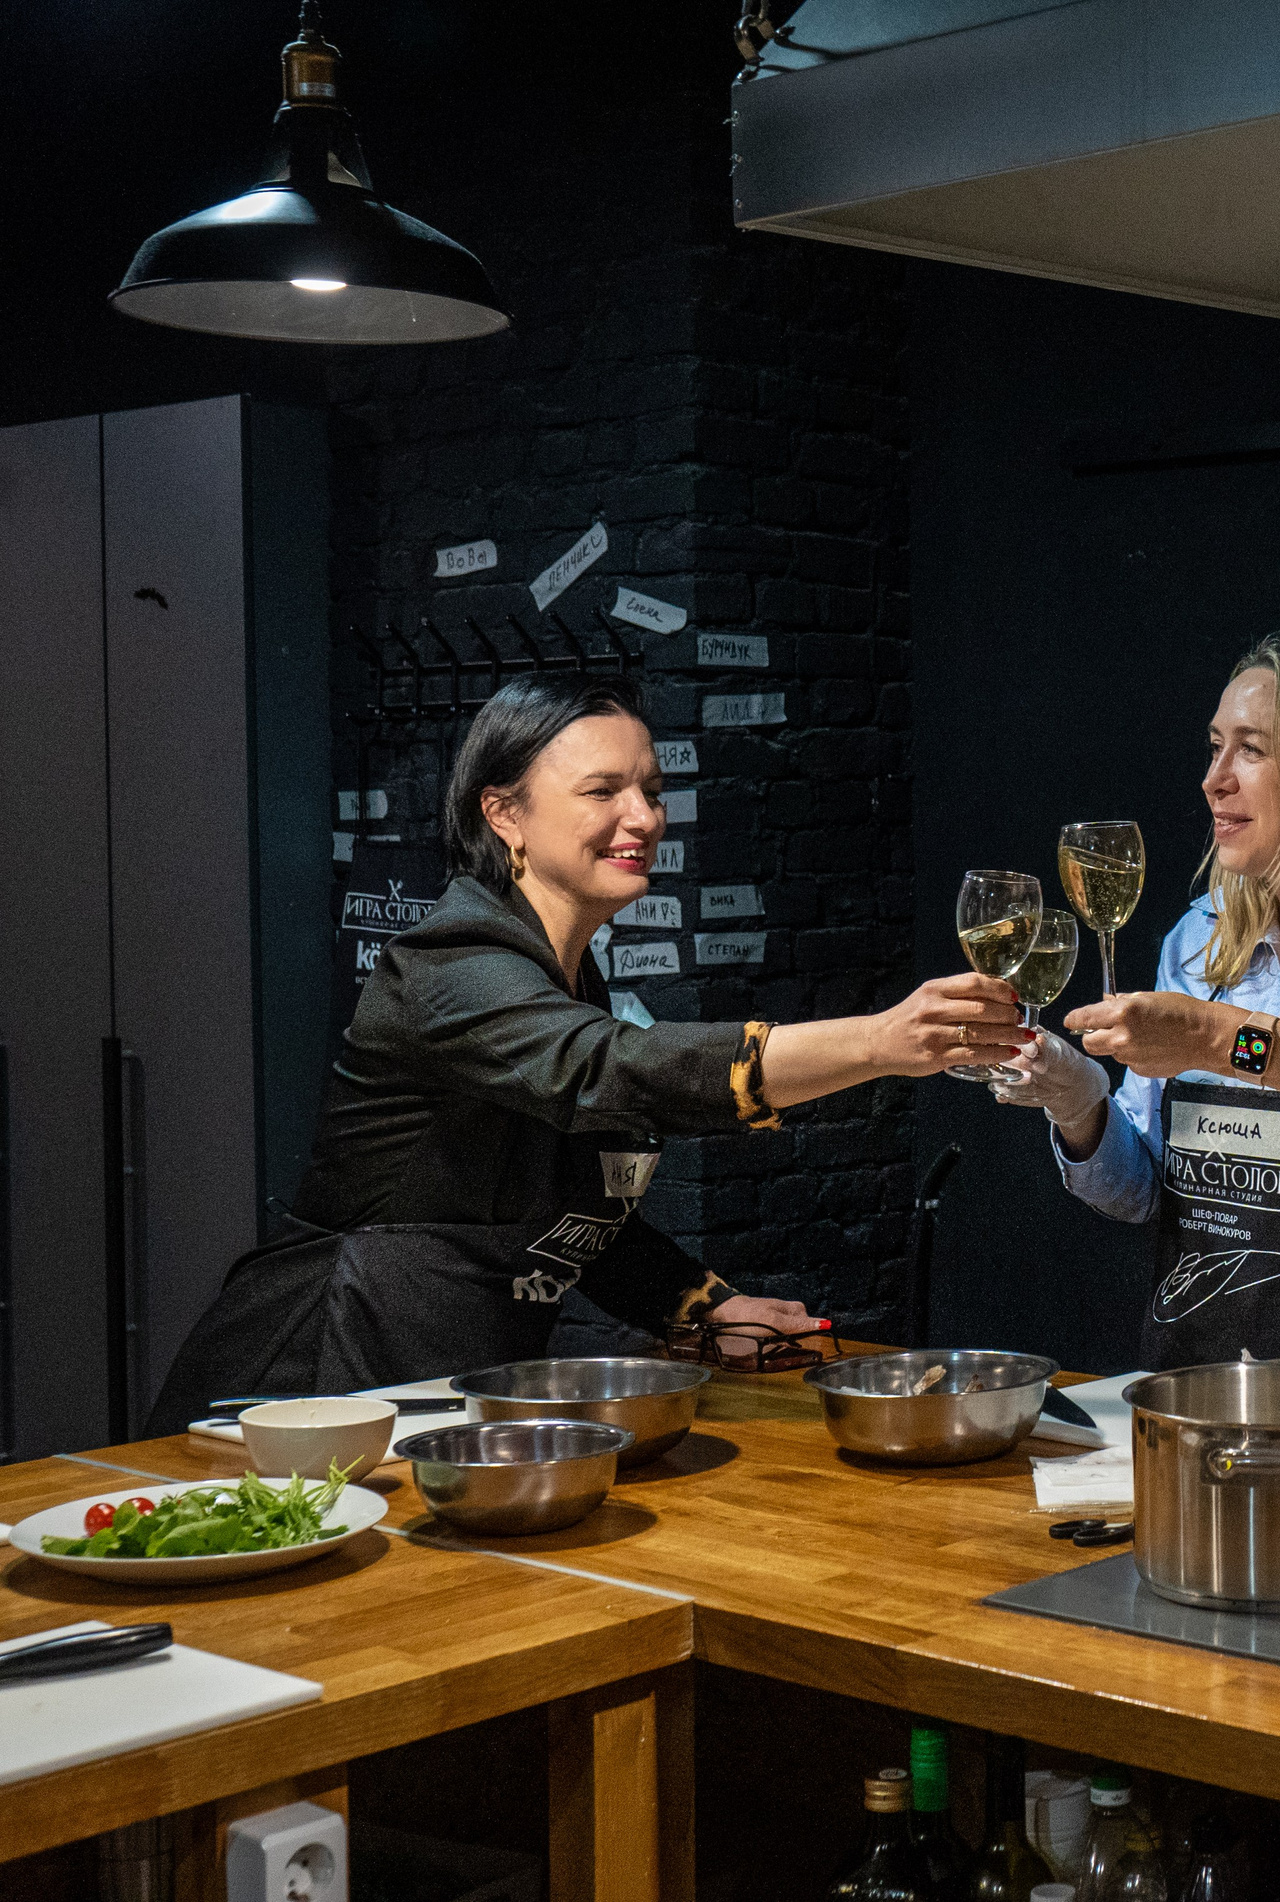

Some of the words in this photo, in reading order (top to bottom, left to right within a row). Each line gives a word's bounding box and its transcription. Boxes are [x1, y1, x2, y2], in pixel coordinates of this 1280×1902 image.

[347, 898, 382, 919] ИГРА
[1230, 1190, 1263, 1203] СТУДИЯ
[1192, 1208, 1239, 1225] ШЕФ-ПОВАР
[1207, 1223, 1252, 1241] ВИНОКУРОВ
